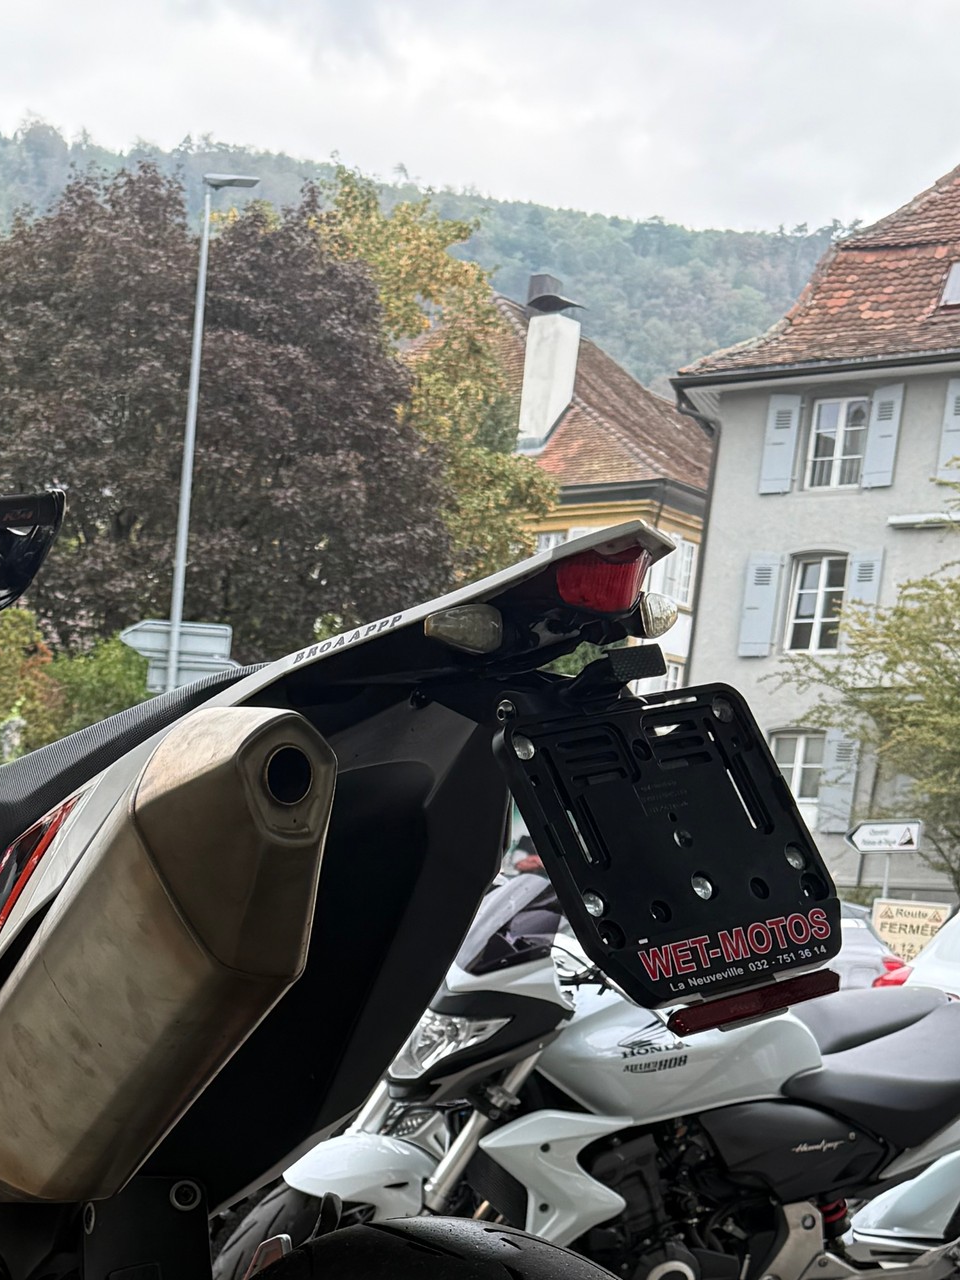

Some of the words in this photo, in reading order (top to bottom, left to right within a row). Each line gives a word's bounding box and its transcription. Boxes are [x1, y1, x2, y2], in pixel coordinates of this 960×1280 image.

[292, 614, 403, 665] BROAAPPP
[895, 908, 928, 919] Route
[638, 908, 831, 982] WET-MOTOS
[669, 981, 685, 992] La
[688, 966, 745, 988] Neuveville
[748, 959, 770, 972] 032
[777, 952, 796, 966] 751
[798, 949, 812, 960] 36
[813, 944, 827, 955] 14
[621, 1041, 691, 1059] HON
